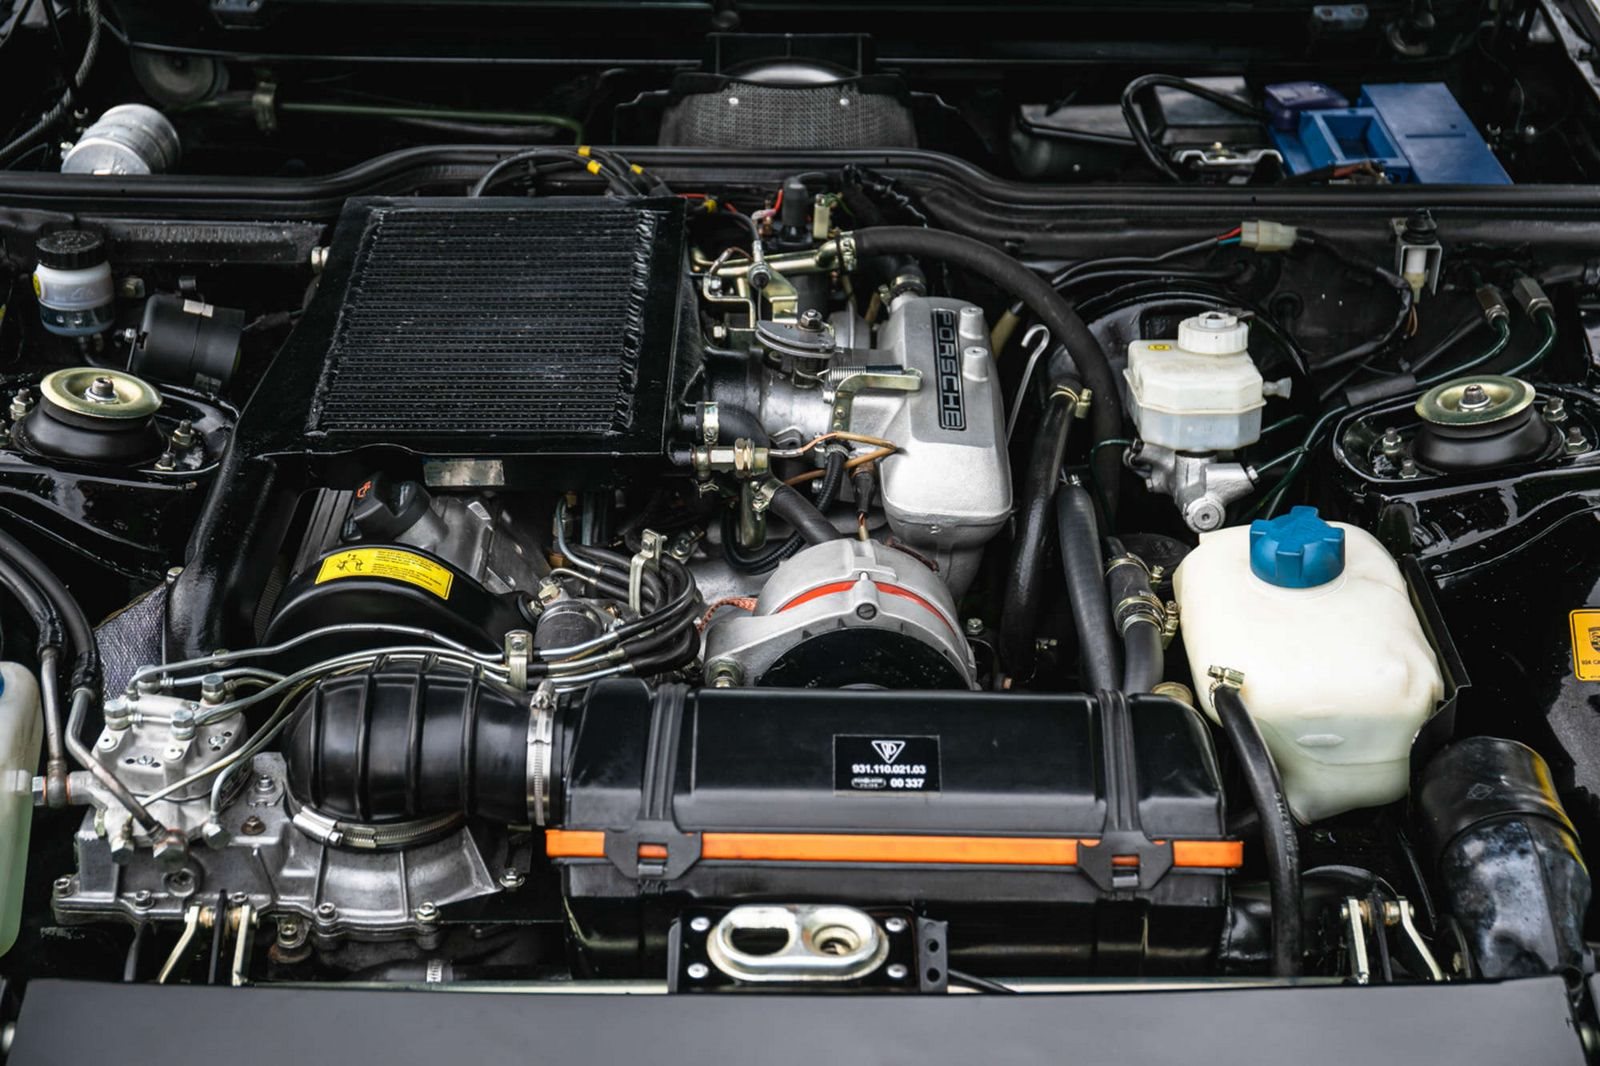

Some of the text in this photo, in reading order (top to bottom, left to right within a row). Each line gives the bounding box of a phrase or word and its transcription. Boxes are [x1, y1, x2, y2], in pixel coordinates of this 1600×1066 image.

[937, 311, 961, 426] PORSCHE
[852, 764, 926, 774] 931.110.021.03
[905, 778, 924, 788] 337
